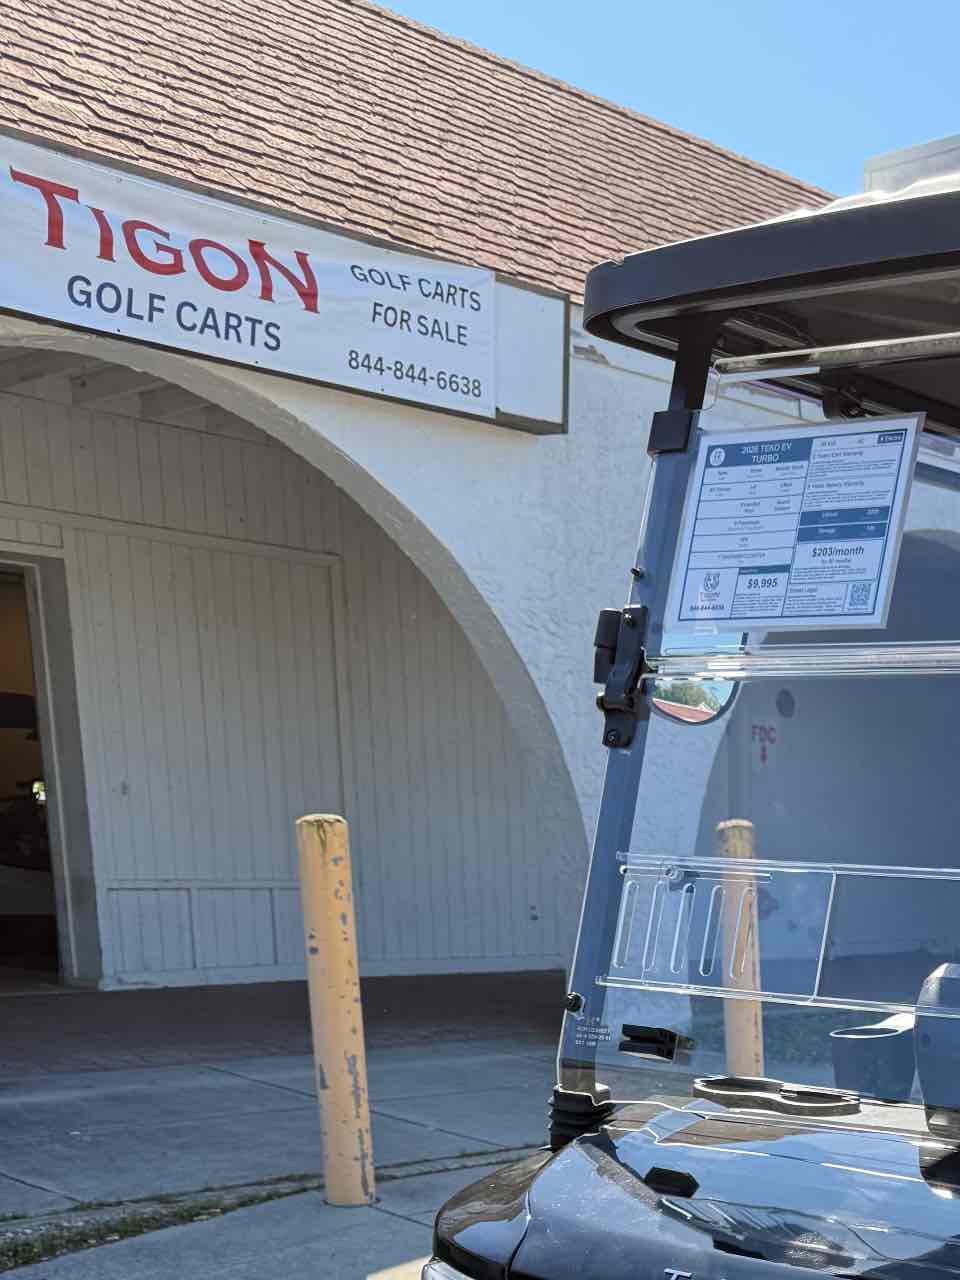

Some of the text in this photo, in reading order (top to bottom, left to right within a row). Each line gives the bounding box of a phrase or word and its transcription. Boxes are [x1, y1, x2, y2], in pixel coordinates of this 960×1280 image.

[8, 165, 321, 313] TIGON
[349, 264, 482, 312] GOLF CARTS
[67, 274, 281, 352] GOLF CARTS
[371, 301, 468, 347] FOR SALE
[348, 349, 482, 398] 844-844-6638
